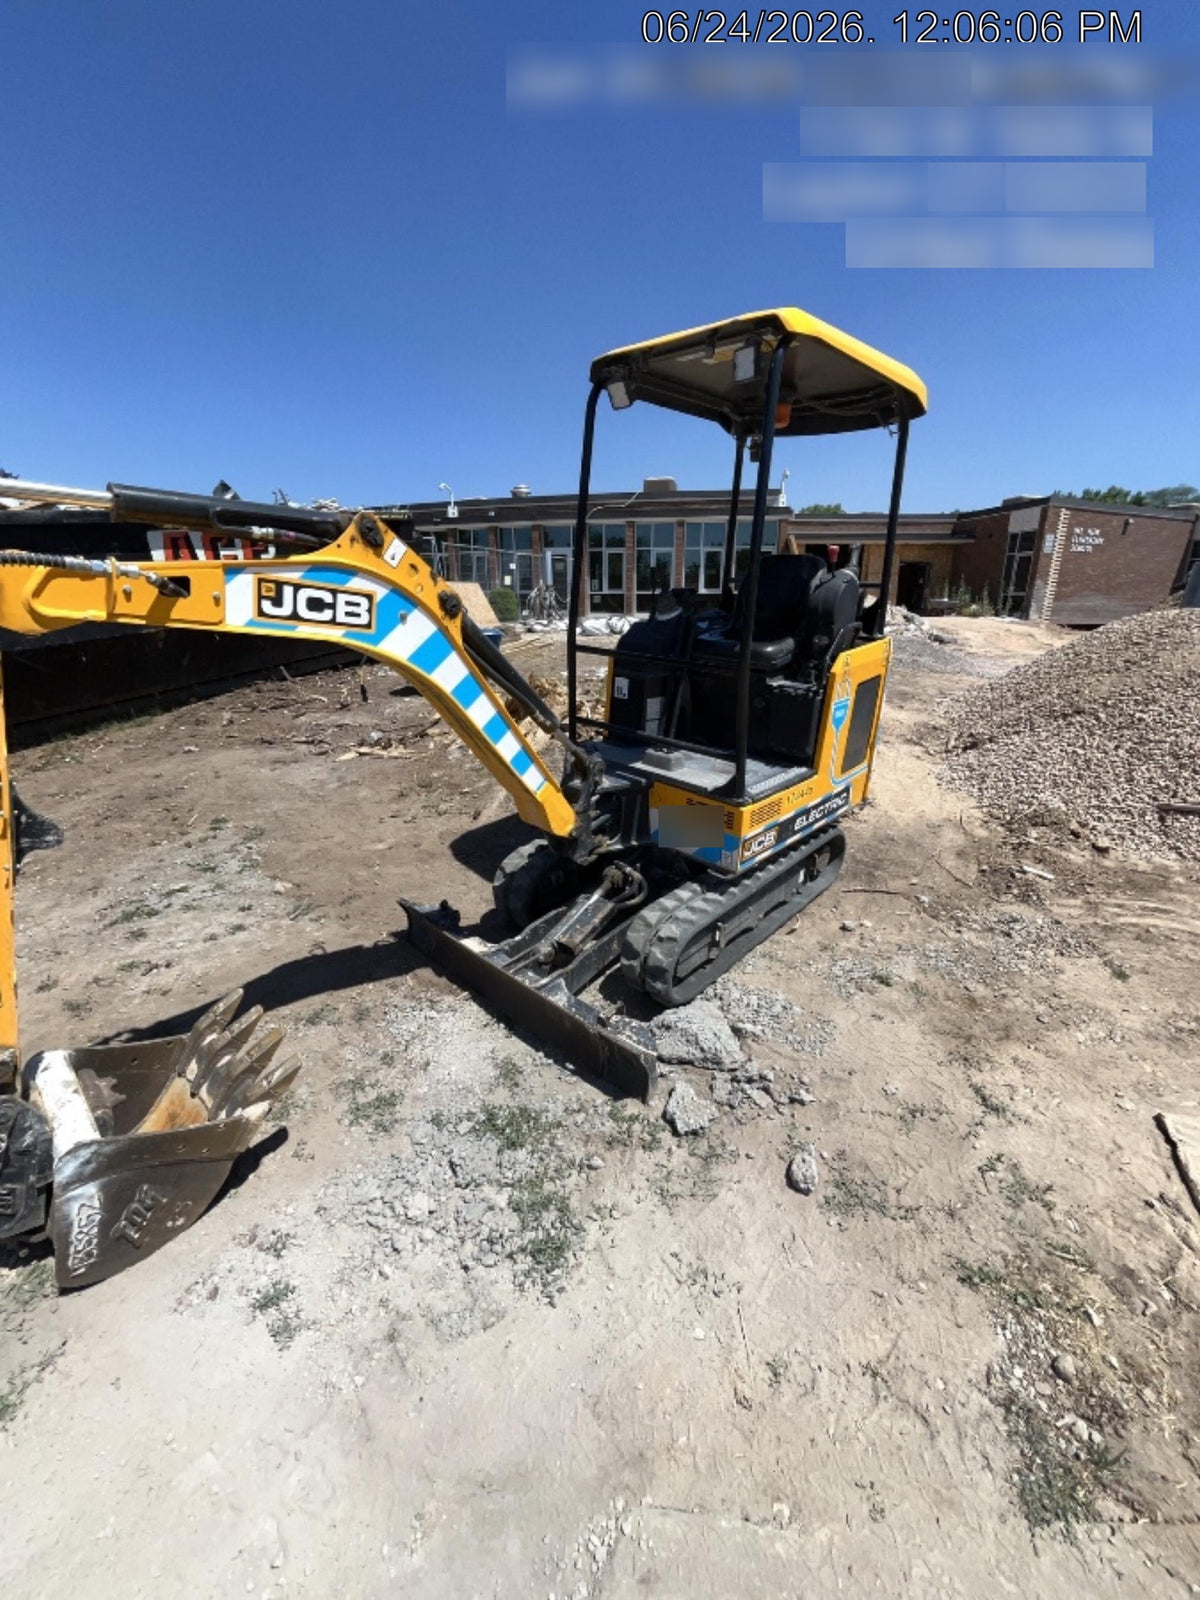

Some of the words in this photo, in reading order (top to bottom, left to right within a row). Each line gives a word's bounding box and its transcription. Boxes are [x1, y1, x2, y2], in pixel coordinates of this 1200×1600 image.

[260, 584, 371, 625] JCB
[744, 831, 777, 857] JCB
[794, 792, 848, 831] ELECTRIC
